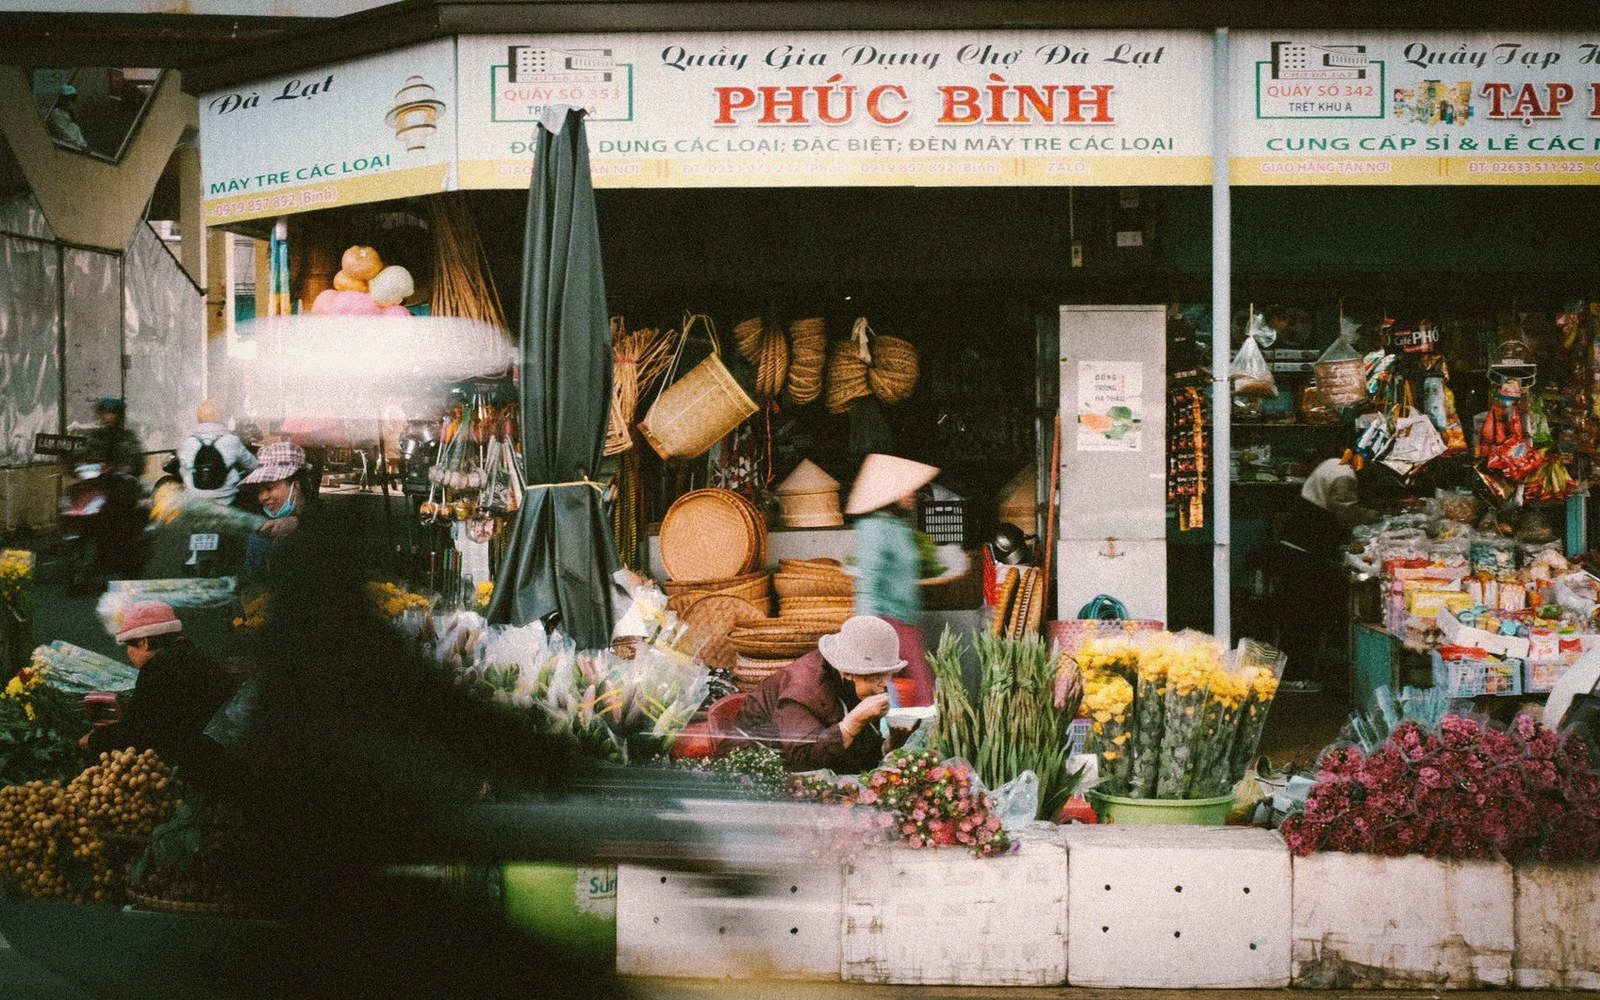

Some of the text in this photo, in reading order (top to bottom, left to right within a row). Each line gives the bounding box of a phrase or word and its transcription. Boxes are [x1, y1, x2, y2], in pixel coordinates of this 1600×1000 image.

[661, 43, 1165, 72] Quầy Gia Dụng Chợ Đà Lạt
[1404, 42, 1488, 69] Quầy
[1495, 42, 1561, 69] Tạp
[209, 75, 334, 115] Đà Lạt
[713, 72, 1116, 125] PHÚC BÌNH
[1267, 82, 1374, 98] QUẦY SỐ 342
[590, 105, 598, 115] A
[1318, 101, 1342, 112] KHU
[1344, 101, 1353, 112] A
[1481, 82, 1575, 127] TẠP
[600, 139, 667, 156] DỤNG
[674, 136, 725, 152] CÁC
[792, 136, 839, 156] ĐẶC
[909, 135, 957, 151] ĐÈN
[964, 136, 1015, 151] MÂY
[1020, 137, 1062, 151] TRE
[1069, 134, 1117, 151] CÁC
[1121, 137, 1174, 154] LOẠI
[1266, 137, 1350, 151] CUNG
[1359, 133, 1417, 151] CẤP
[1458, 137, 1480, 151] &
[1488, 133, 1519, 151] LẺ
[1527, 134, 1585, 151] CÁC
[210, 153, 391, 195] MÂY TRE CÁC LOẠI
[1262, 162, 1294, 173] GIAO
[1297, 160, 1335, 173] HÀNG
[1492, 162, 1531, 173] 02633
[1535, 162, 1557, 173] 511
[1561, 162, 1584, 173] 925
